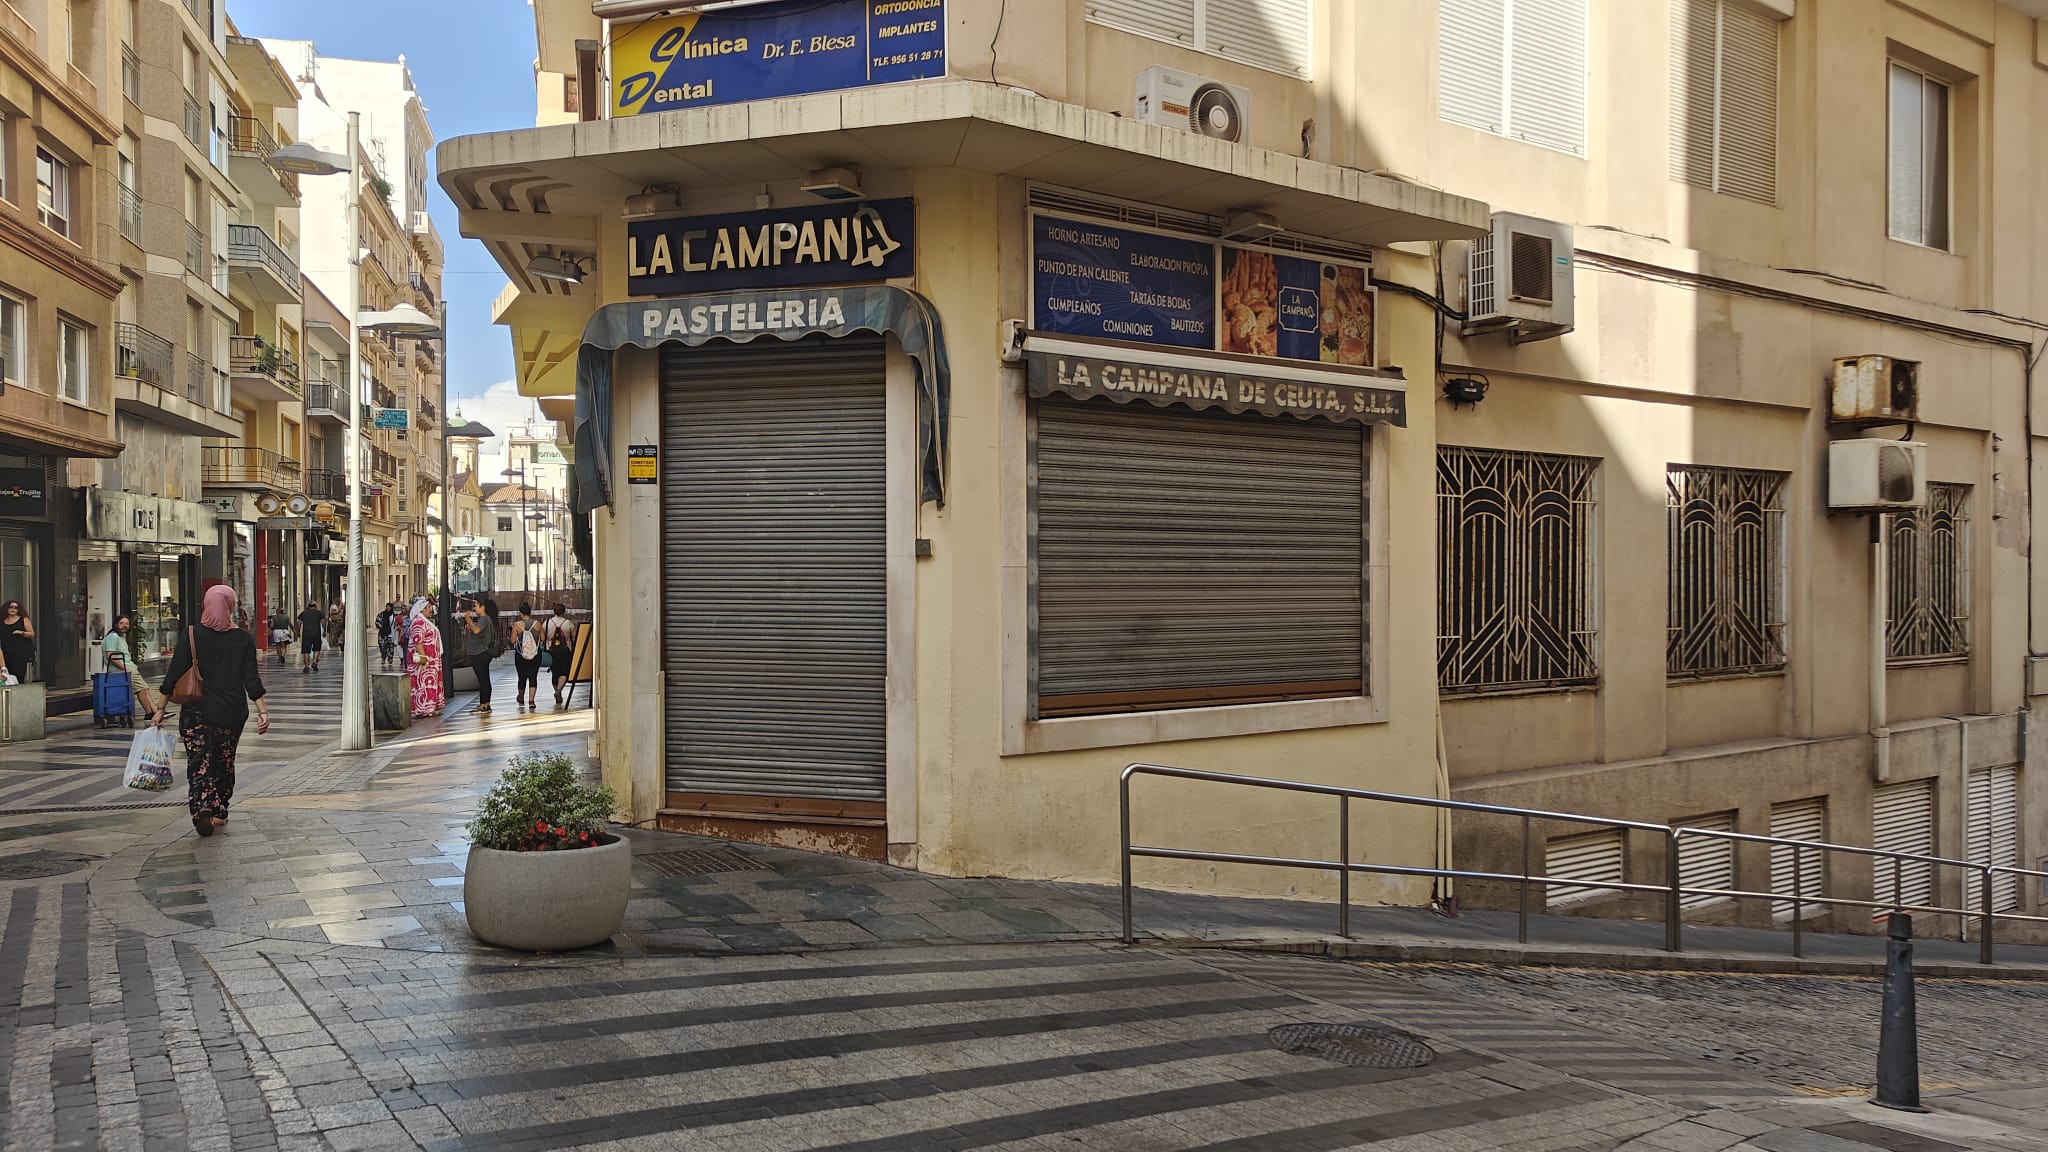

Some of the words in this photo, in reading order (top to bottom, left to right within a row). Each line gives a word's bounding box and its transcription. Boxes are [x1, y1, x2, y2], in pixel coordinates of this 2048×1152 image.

[874, 0, 941, 15] ORTODONCIA
[878, 20, 937, 38] IMPLANTES
[650, 27, 748, 62] Clínica
[762, 43, 784, 59] Dr.
[790, 40, 804, 56] E.
[810, 35, 856, 52] Blesa
[873, 56, 889, 67] TLF.
[891, 54, 906, 65] 956
[908, 53, 918, 62] 51
[921, 51, 931, 61] 28
[933, 49, 943, 59] 71
[619, 71, 713, 107] Dental
[629, 234, 673, 276] LA
[683, 207, 901, 273] CAMPANA
[1049, 227, 1078, 243] HORNO
[1080, 233, 1120, 250] ARTESANO
[1038, 259, 1066, 275] PUNTO
[1067, 264, 1077, 277] DE
[1078, 266, 1094, 279] PAN
[1095, 269, 1130, 284] CALIENTE
[1182, 261, 1208, 277] PROPIA
[1048, 297, 1101, 316] CUMPLEAÑOS
[1130, 291, 1156, 307] TARTAS
[1157, 295, 1167, 308] DE
[1167, 296, 1191, 311] BODAS
[1291, 294, 1301, 304] LA
[643, 297, 845, 337] PASTELERIA
[1282, 304, 1316, 319] CAMPANA
[1103, 319, 1153, 337] COMUNIONES
[1171, 318, 1205, 334] BAUTIZOS
[1057, 359, 1092, 388] LA
[1101, 365, 1228, 401] CAMPANA
[1238, 380, 1266, 405] DE
[1274, 382, 1347, 413] CEUTA,
